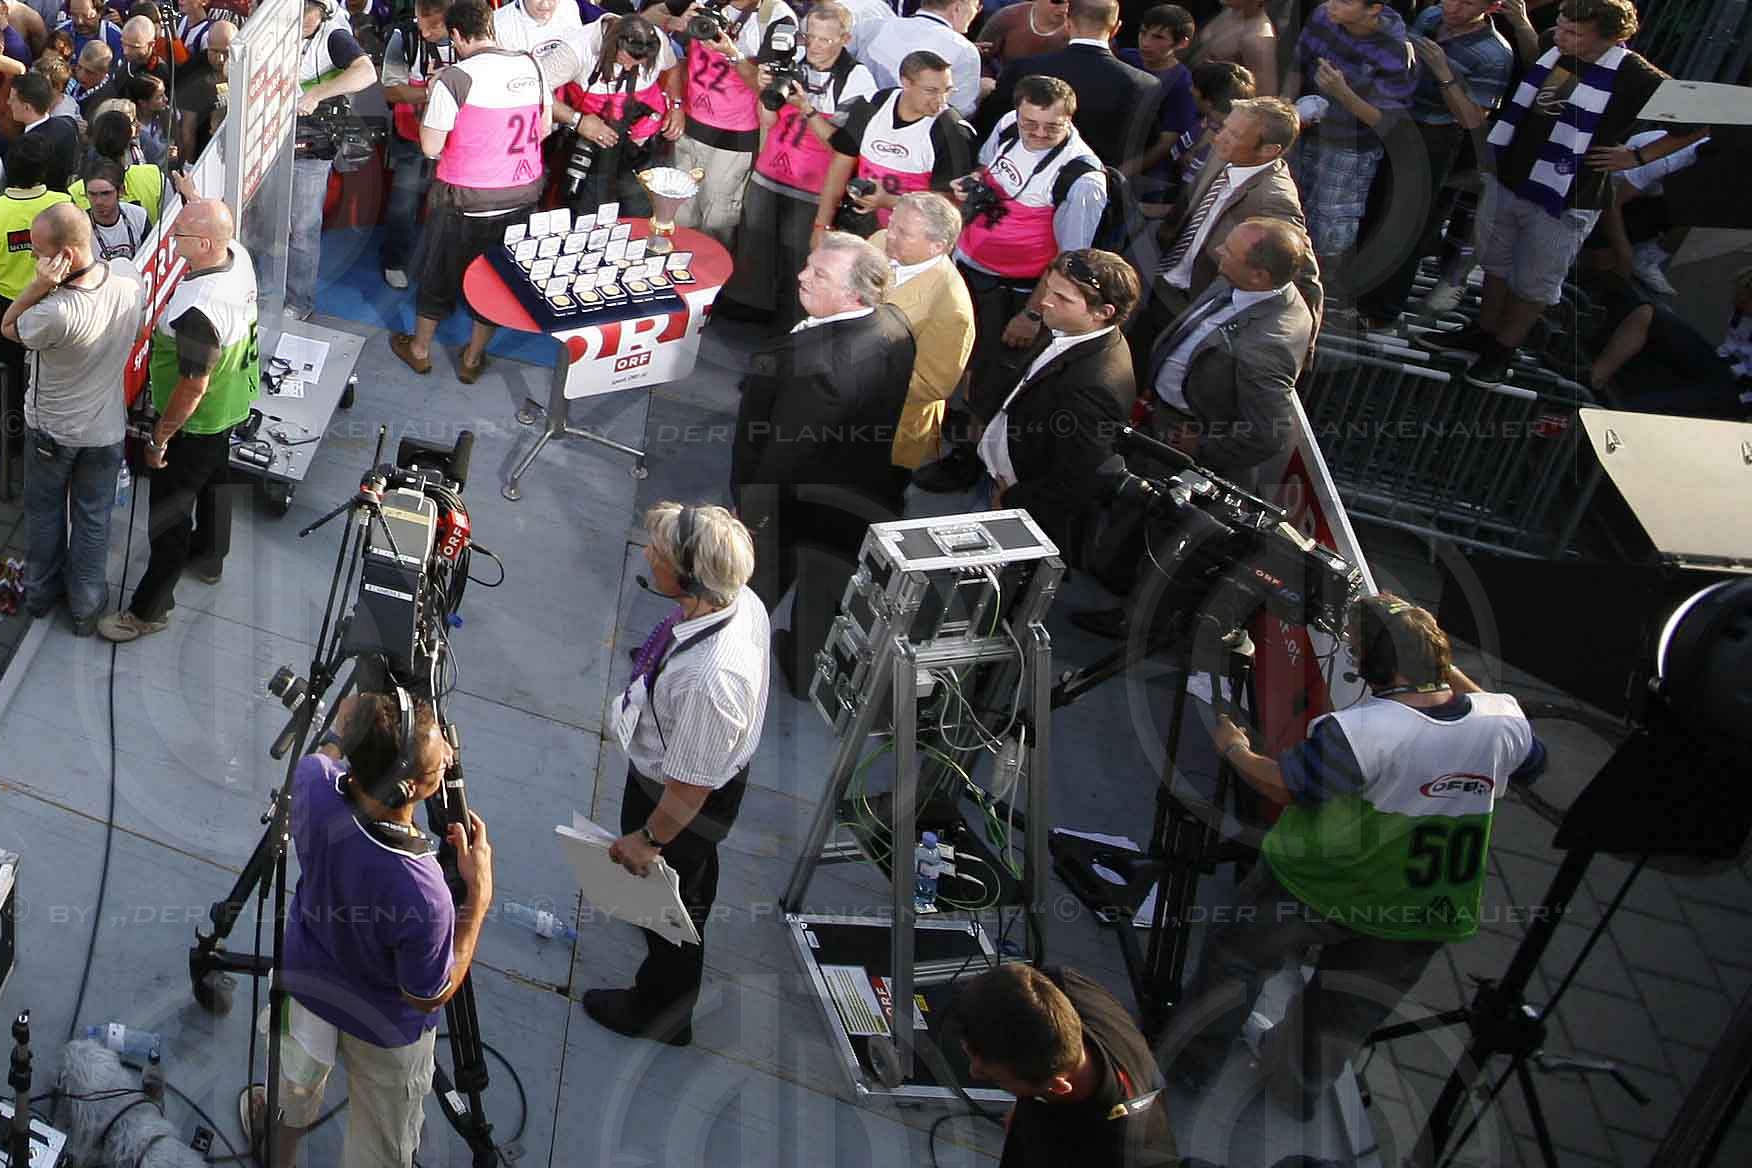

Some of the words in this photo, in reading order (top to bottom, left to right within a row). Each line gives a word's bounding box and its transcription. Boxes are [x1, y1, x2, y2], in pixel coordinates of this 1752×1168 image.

[692, 51, 730, 93] 22
[507, 111, 540, 154] 24
[616, 354, 650, 370] ORF
[443, 526, 463, 557] ORF
[1405, 824, 1483, 887] 50
